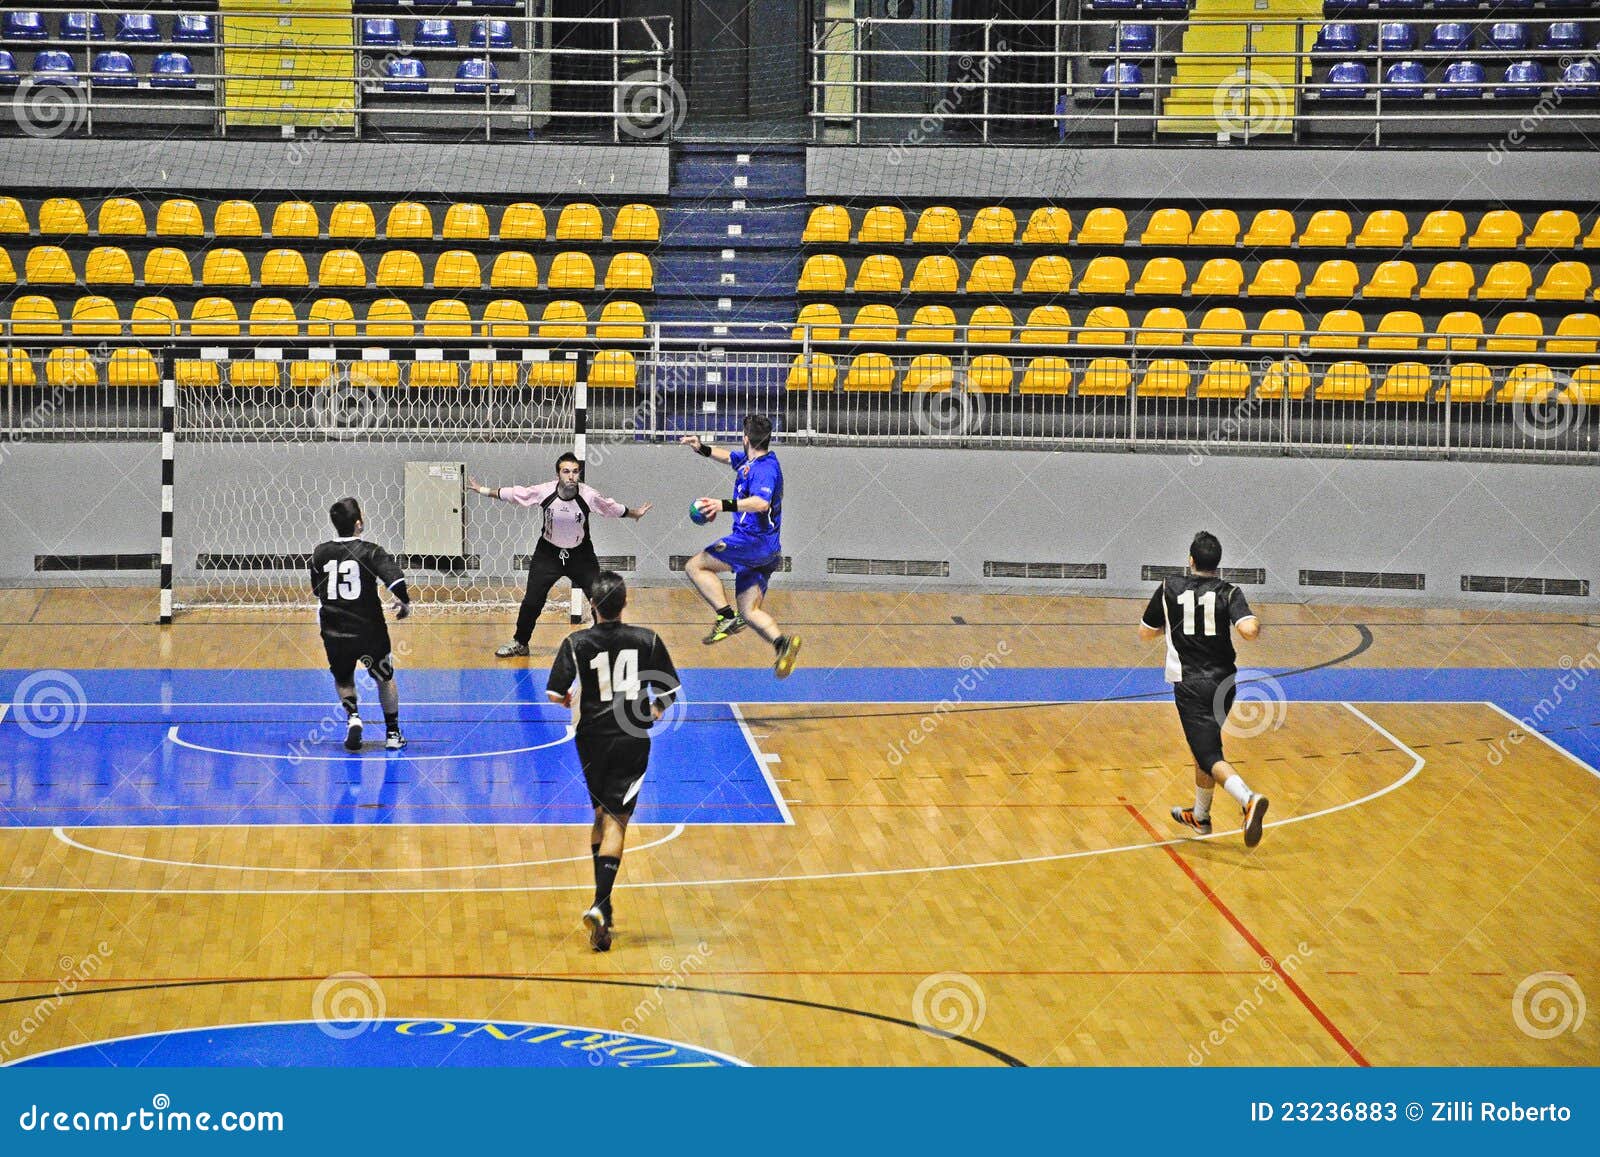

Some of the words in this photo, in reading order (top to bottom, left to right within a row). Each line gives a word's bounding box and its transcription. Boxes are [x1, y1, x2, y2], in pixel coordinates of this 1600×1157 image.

[323, 560, 361, 600] 13
[1177, 589, 1216, 636] 11
[590, 649, 641, 701] 14
